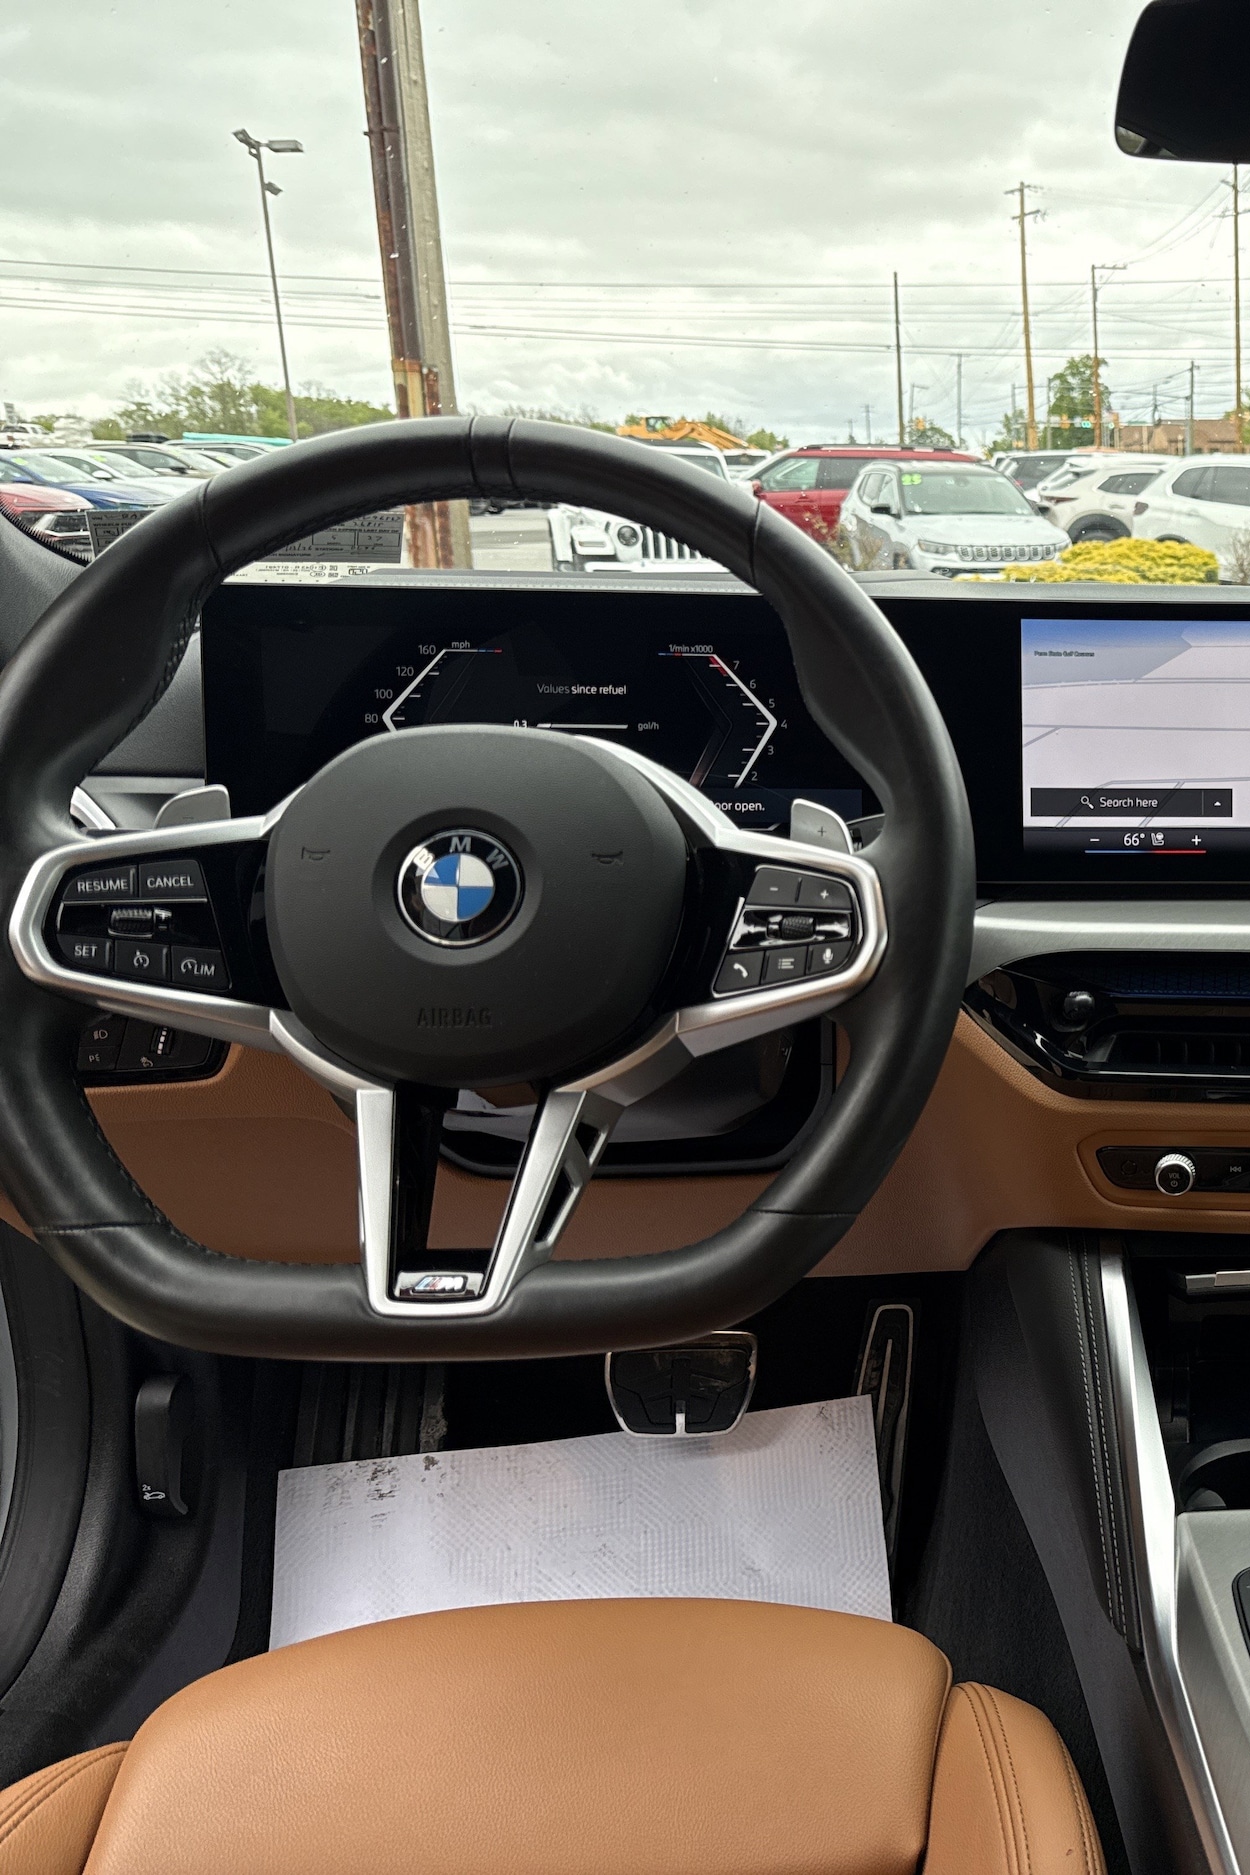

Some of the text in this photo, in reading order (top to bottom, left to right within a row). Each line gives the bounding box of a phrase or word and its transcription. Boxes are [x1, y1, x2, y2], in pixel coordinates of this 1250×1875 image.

[418, 645, 436, 655] 160
[669, 644, 714, 653] 1/min x1000
[733, 661, 740, 670] 7
[396, 667, 414, 677] 120
[537, 683, 627, 695] Values since refuel
[749, 679, 757, 689] 6
[374, 689, 393, 699] 100
[768, 698, 775, 708] 5
[364, 713, 379, 723] 80
[637, 721, 660, 731] gal/h
[780, 719, 788, 729] 4
[767, 745, 774, 755] 3
[751, 771, 758, 781] 2
[1099, 797, 1159, 807] Search here
[734, 802, 766, 813] open.
[1123, 832, 1146, 846] 66°
[413, 836, 510, 872] BMW
[77, 878, 129, 893] RESUME
[146, 875, 195, 889] CANCEL
[74, 944, 99, 958] SET
[193, 963, 216, 976] LIM
[416, 1006, 495, 1028] AIRBAG
[1168, 1172, 1181, 1180] VOL
